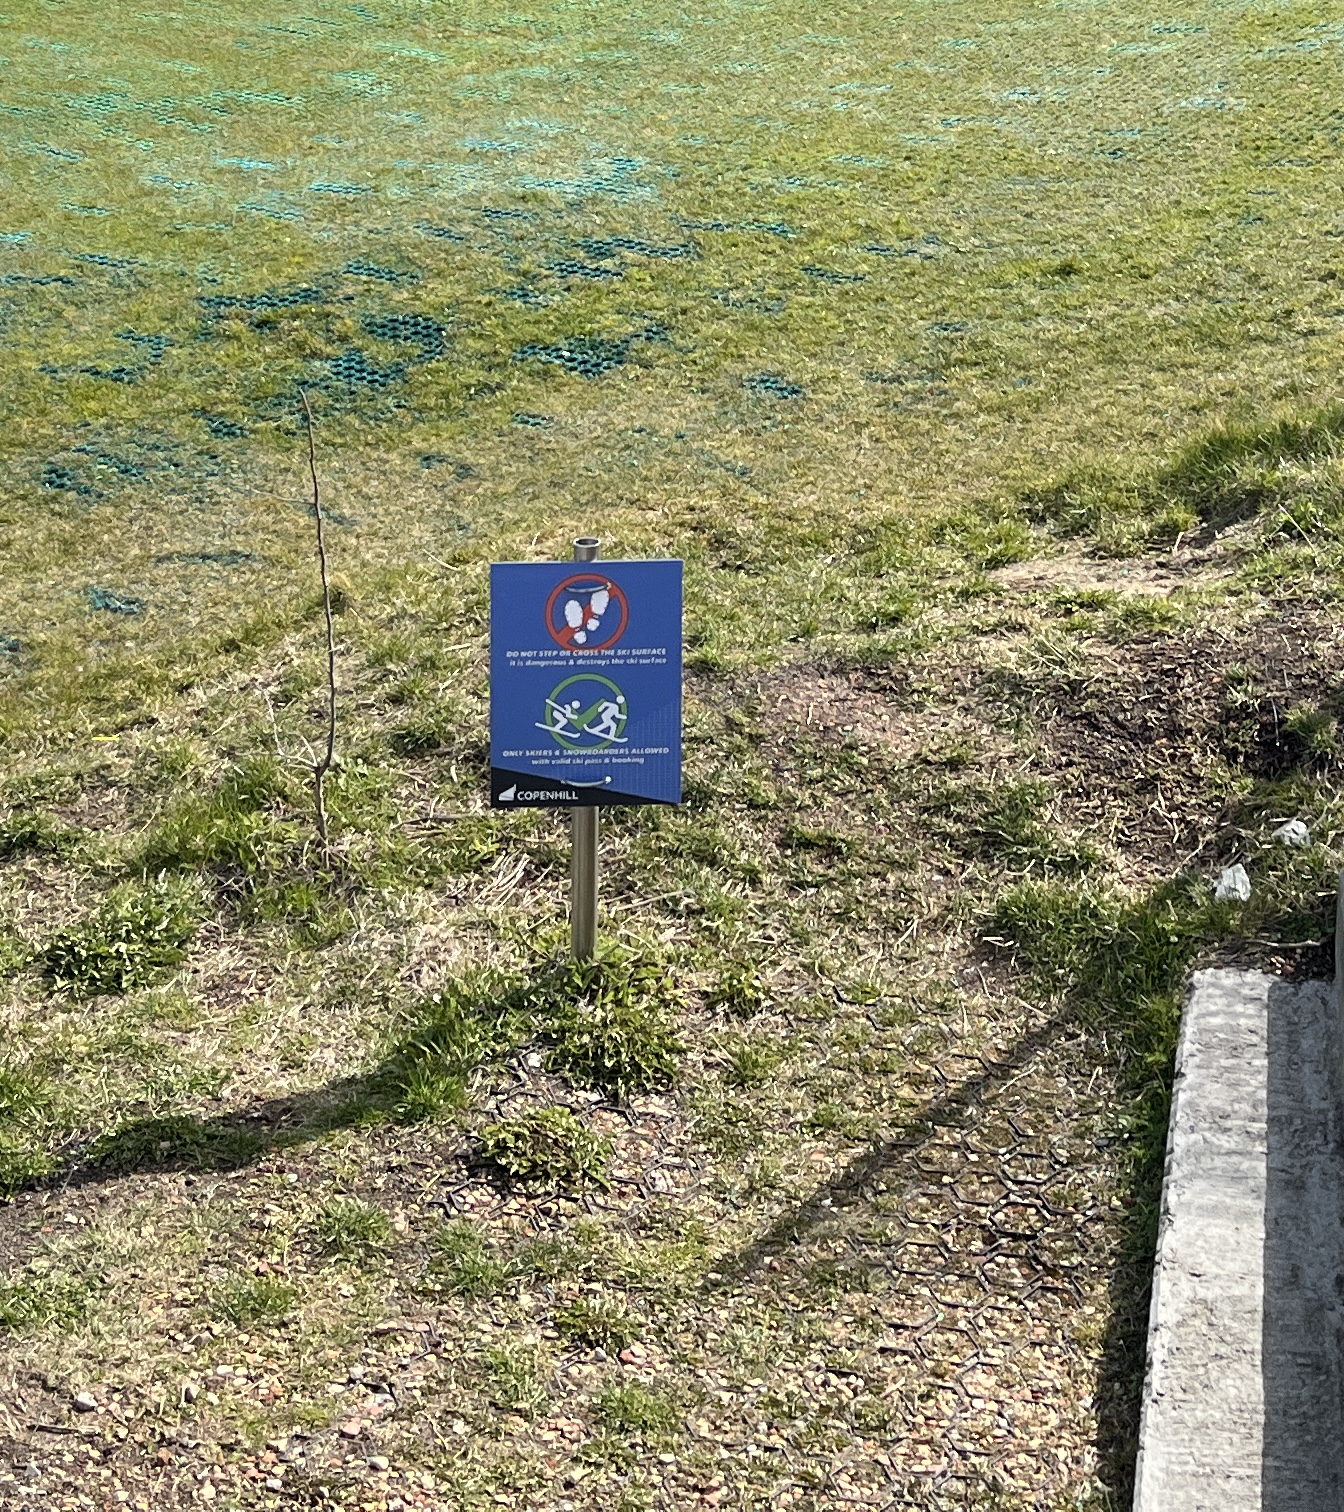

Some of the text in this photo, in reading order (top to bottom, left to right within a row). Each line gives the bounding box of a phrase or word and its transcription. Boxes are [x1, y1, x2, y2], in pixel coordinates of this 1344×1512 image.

[506, 650, 519, 658] DO
[525, 659, 567, 667] dangerous
[576, 658, 610, 666] destroys
[611, 757, 645, 765] booking
[517, 790, 579, 801] COPENHILL
